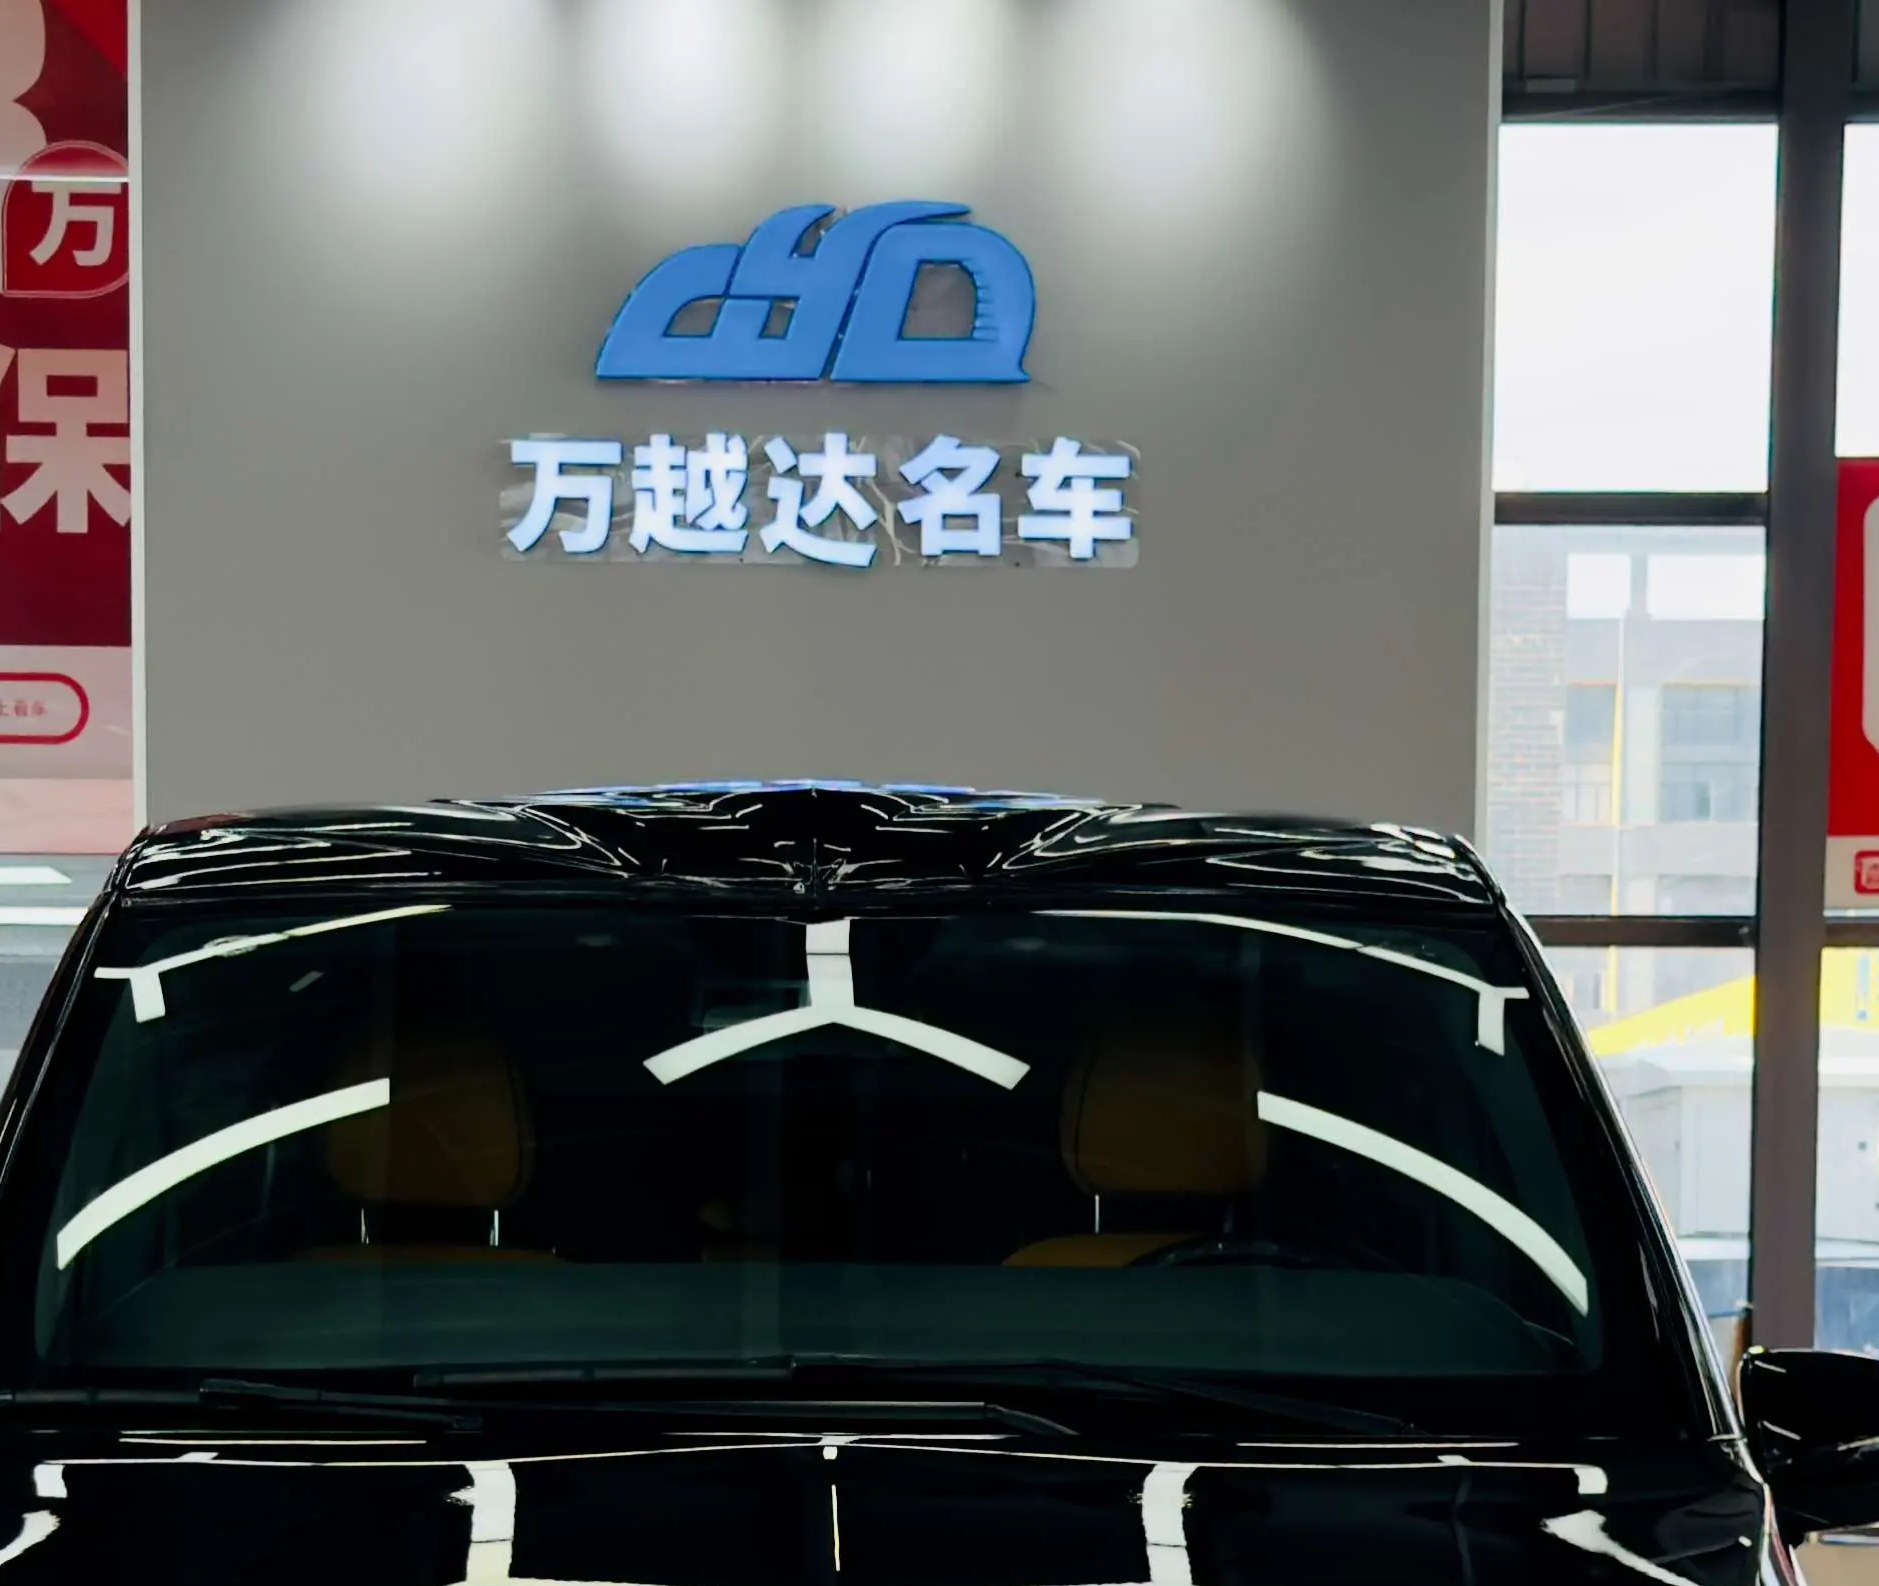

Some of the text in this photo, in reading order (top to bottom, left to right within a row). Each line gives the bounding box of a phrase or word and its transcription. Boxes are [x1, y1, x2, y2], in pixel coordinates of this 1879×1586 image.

[505, 433, 1134, 568] 万越达名车
